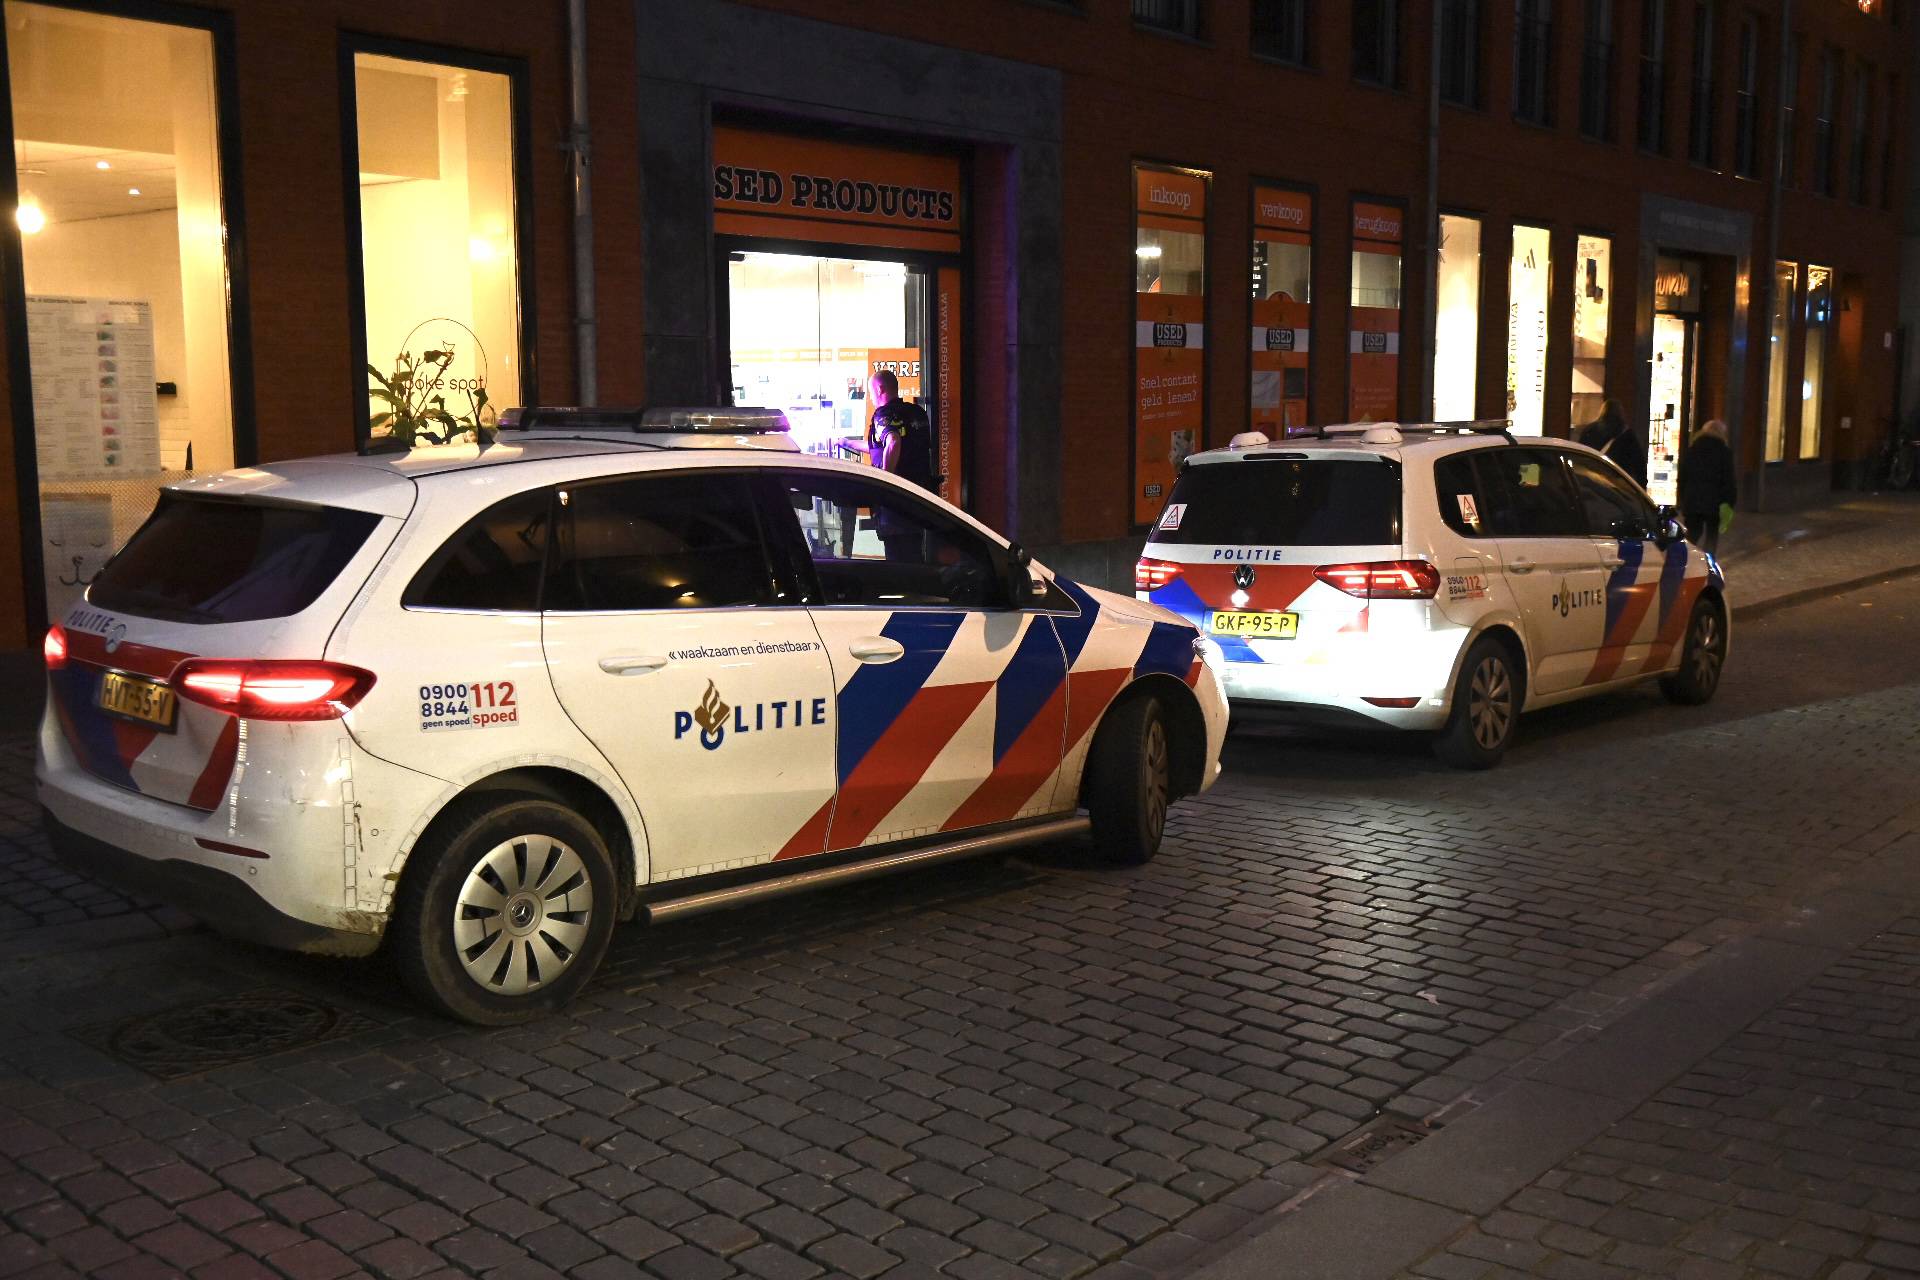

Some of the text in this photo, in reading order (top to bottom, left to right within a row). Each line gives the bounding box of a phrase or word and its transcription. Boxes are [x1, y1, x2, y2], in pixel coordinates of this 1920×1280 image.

[714, 164, 953, 221] SED PRODUCTS
[1150, 185, 1191, 210] inkoop
[1260, 203, 1303, 224] verkoop
[1354, 216, 1400, 236] terugkoop
[1156, 324, 1184, 339] USED
[1269, 330, 1292, 343] USED
[1365, 333, 1385, 346] USED
[450, 376, 484, 395] spot
[1141, 393, 1162, 410] geld
[1213, 549, 1282, 561] POLITIE
[1465, 575, 1482, 591] 112
[1552, 589, 1602, 617] POLITIE
[1216, 614, 1289, 632] GKF-95-P
[740, 646, 754, 655] en
[420, 684, 467, 700] 0900
[470, 682, 516, 708] 112
[421, 701, 469, 717] 8844
[473, 708, 517, 727] spoed
[422, 717, 470, 730] geen spoed
[674, 698, 826, 751] POLITIE
